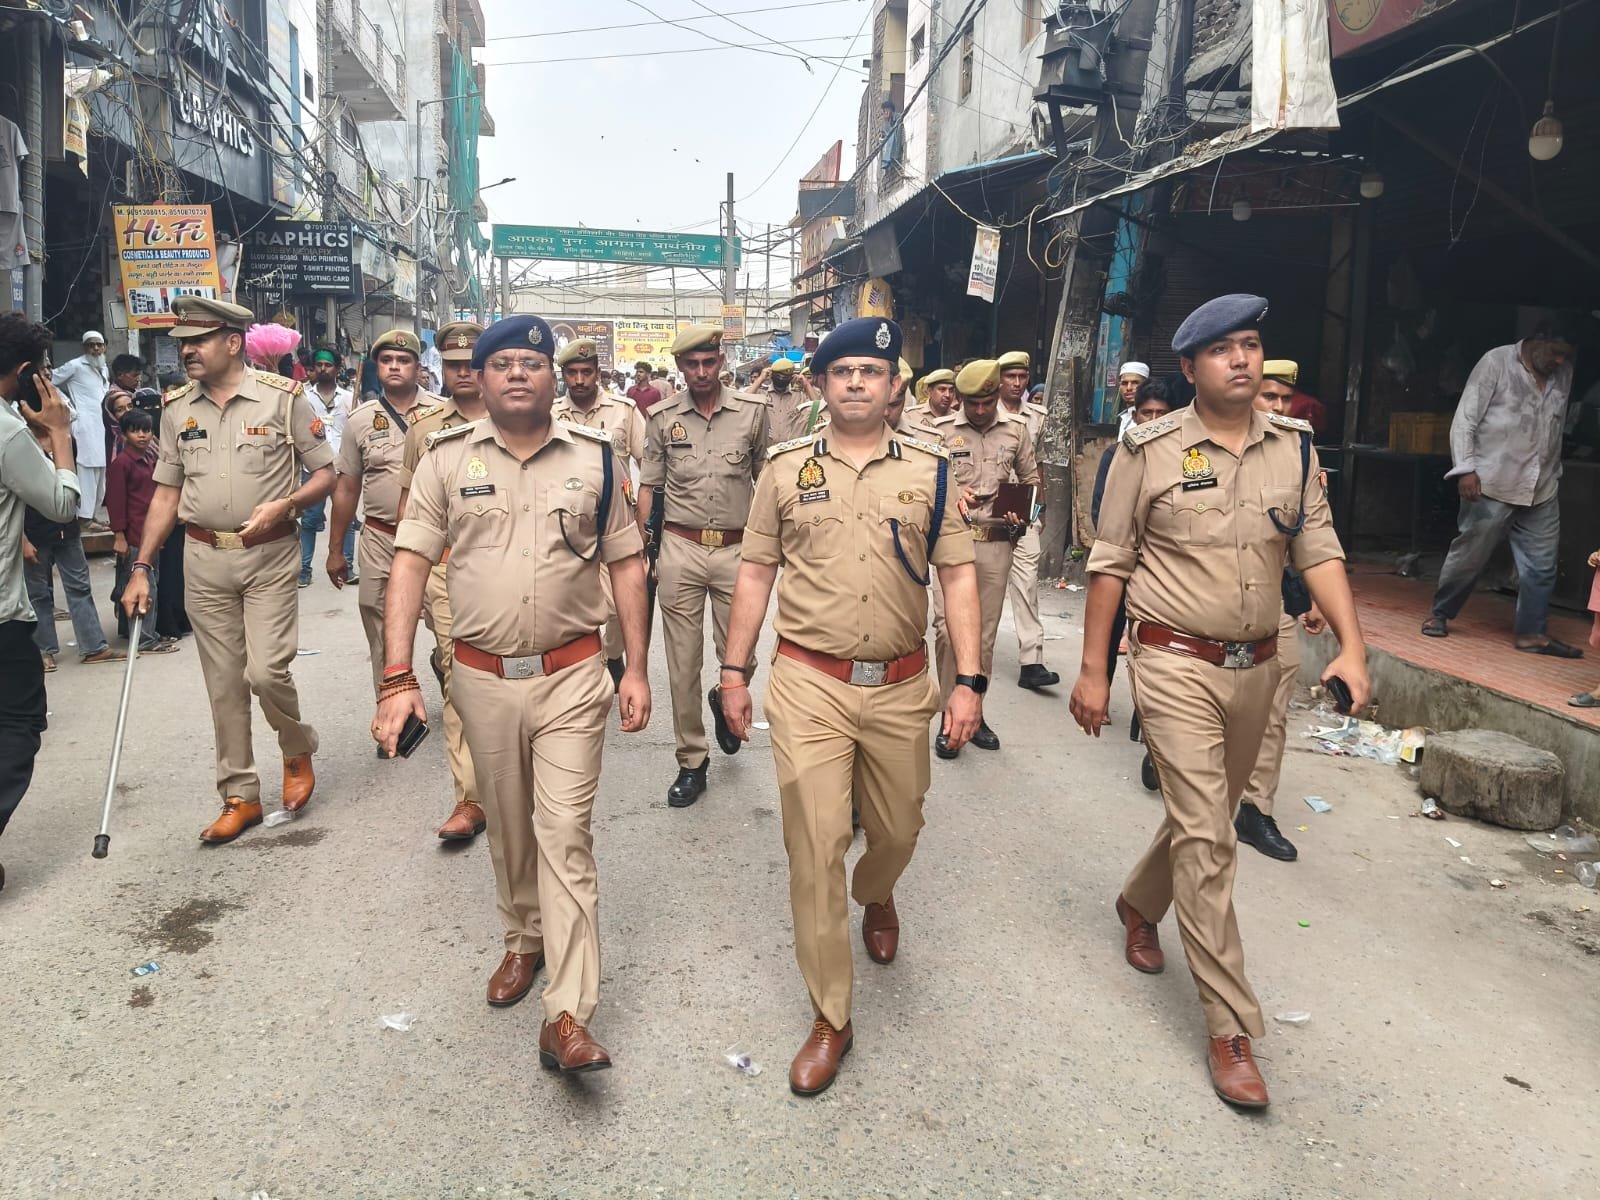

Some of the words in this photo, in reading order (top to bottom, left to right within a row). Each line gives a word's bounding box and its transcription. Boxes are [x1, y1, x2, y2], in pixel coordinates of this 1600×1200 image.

[180, 90, 255, 158] GRAPHICS
[507, 235, 555, 244] आपका
[562, 237, 588, 247] पुनः
[595, 239, 645, 249] आगमन
[123, 250, 154, 259] COSMETICS
[160, 249, 181, 259] BEAUTY
[182, 249, 210, 258] PRODUCTS
[318, 255, 349, 263] PRINTING
